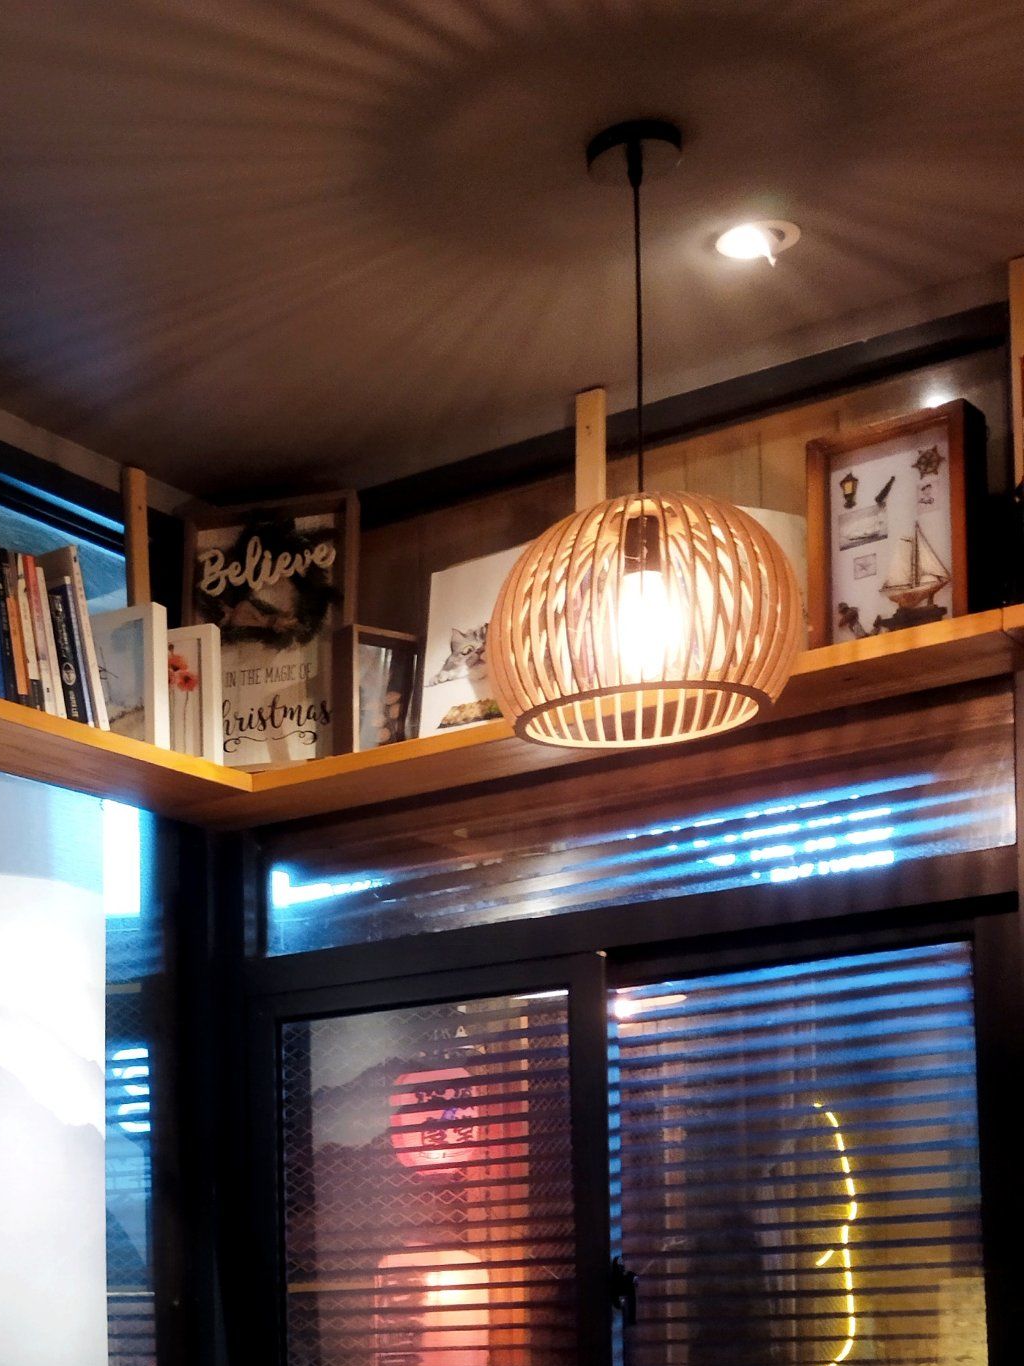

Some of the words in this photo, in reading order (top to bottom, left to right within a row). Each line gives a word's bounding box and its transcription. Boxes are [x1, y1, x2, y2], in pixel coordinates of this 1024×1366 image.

[197, 535, 336, 597] Believe
[241, 667, 261, 686] THE
[264, 664, 296, 685] MAGIC
[299, 662, 313, 681] OF
[221, 694, 333, 737] hristmas
